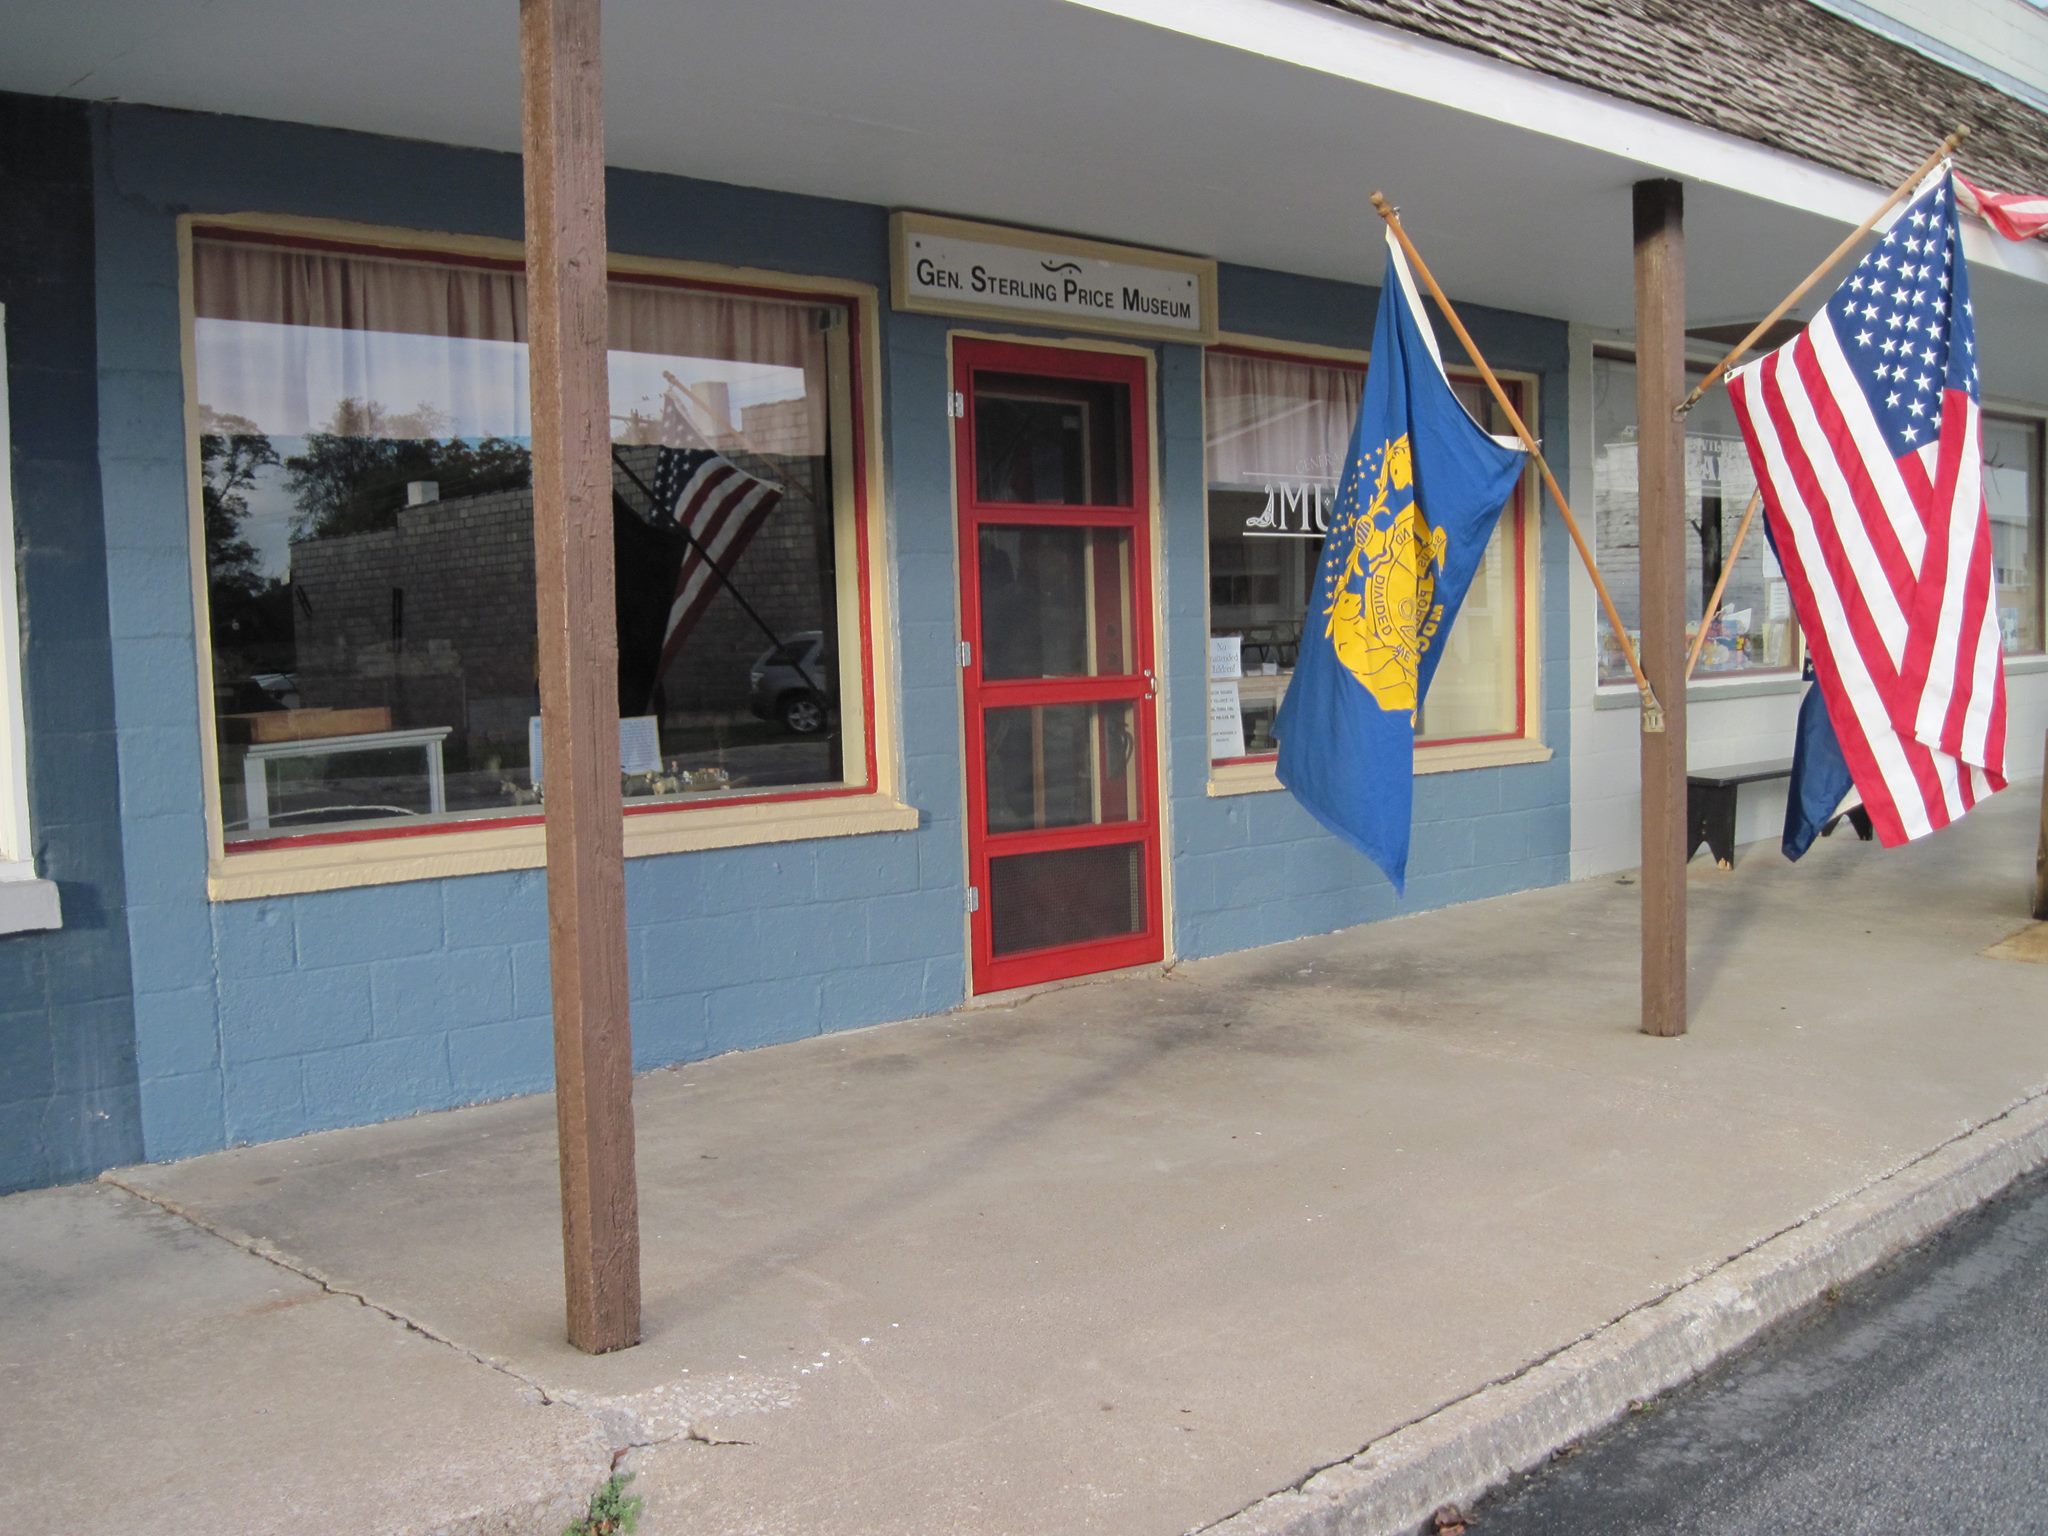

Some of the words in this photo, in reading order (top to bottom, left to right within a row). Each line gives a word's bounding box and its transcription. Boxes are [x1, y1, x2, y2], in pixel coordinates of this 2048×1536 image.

[917, 258, 963, 290] GEN.
[971, 265, 1057, 302] STERLING
[1063, 278, 1114, 309] PRICE
[1122, 287, 1191, 319] MUSEUM
